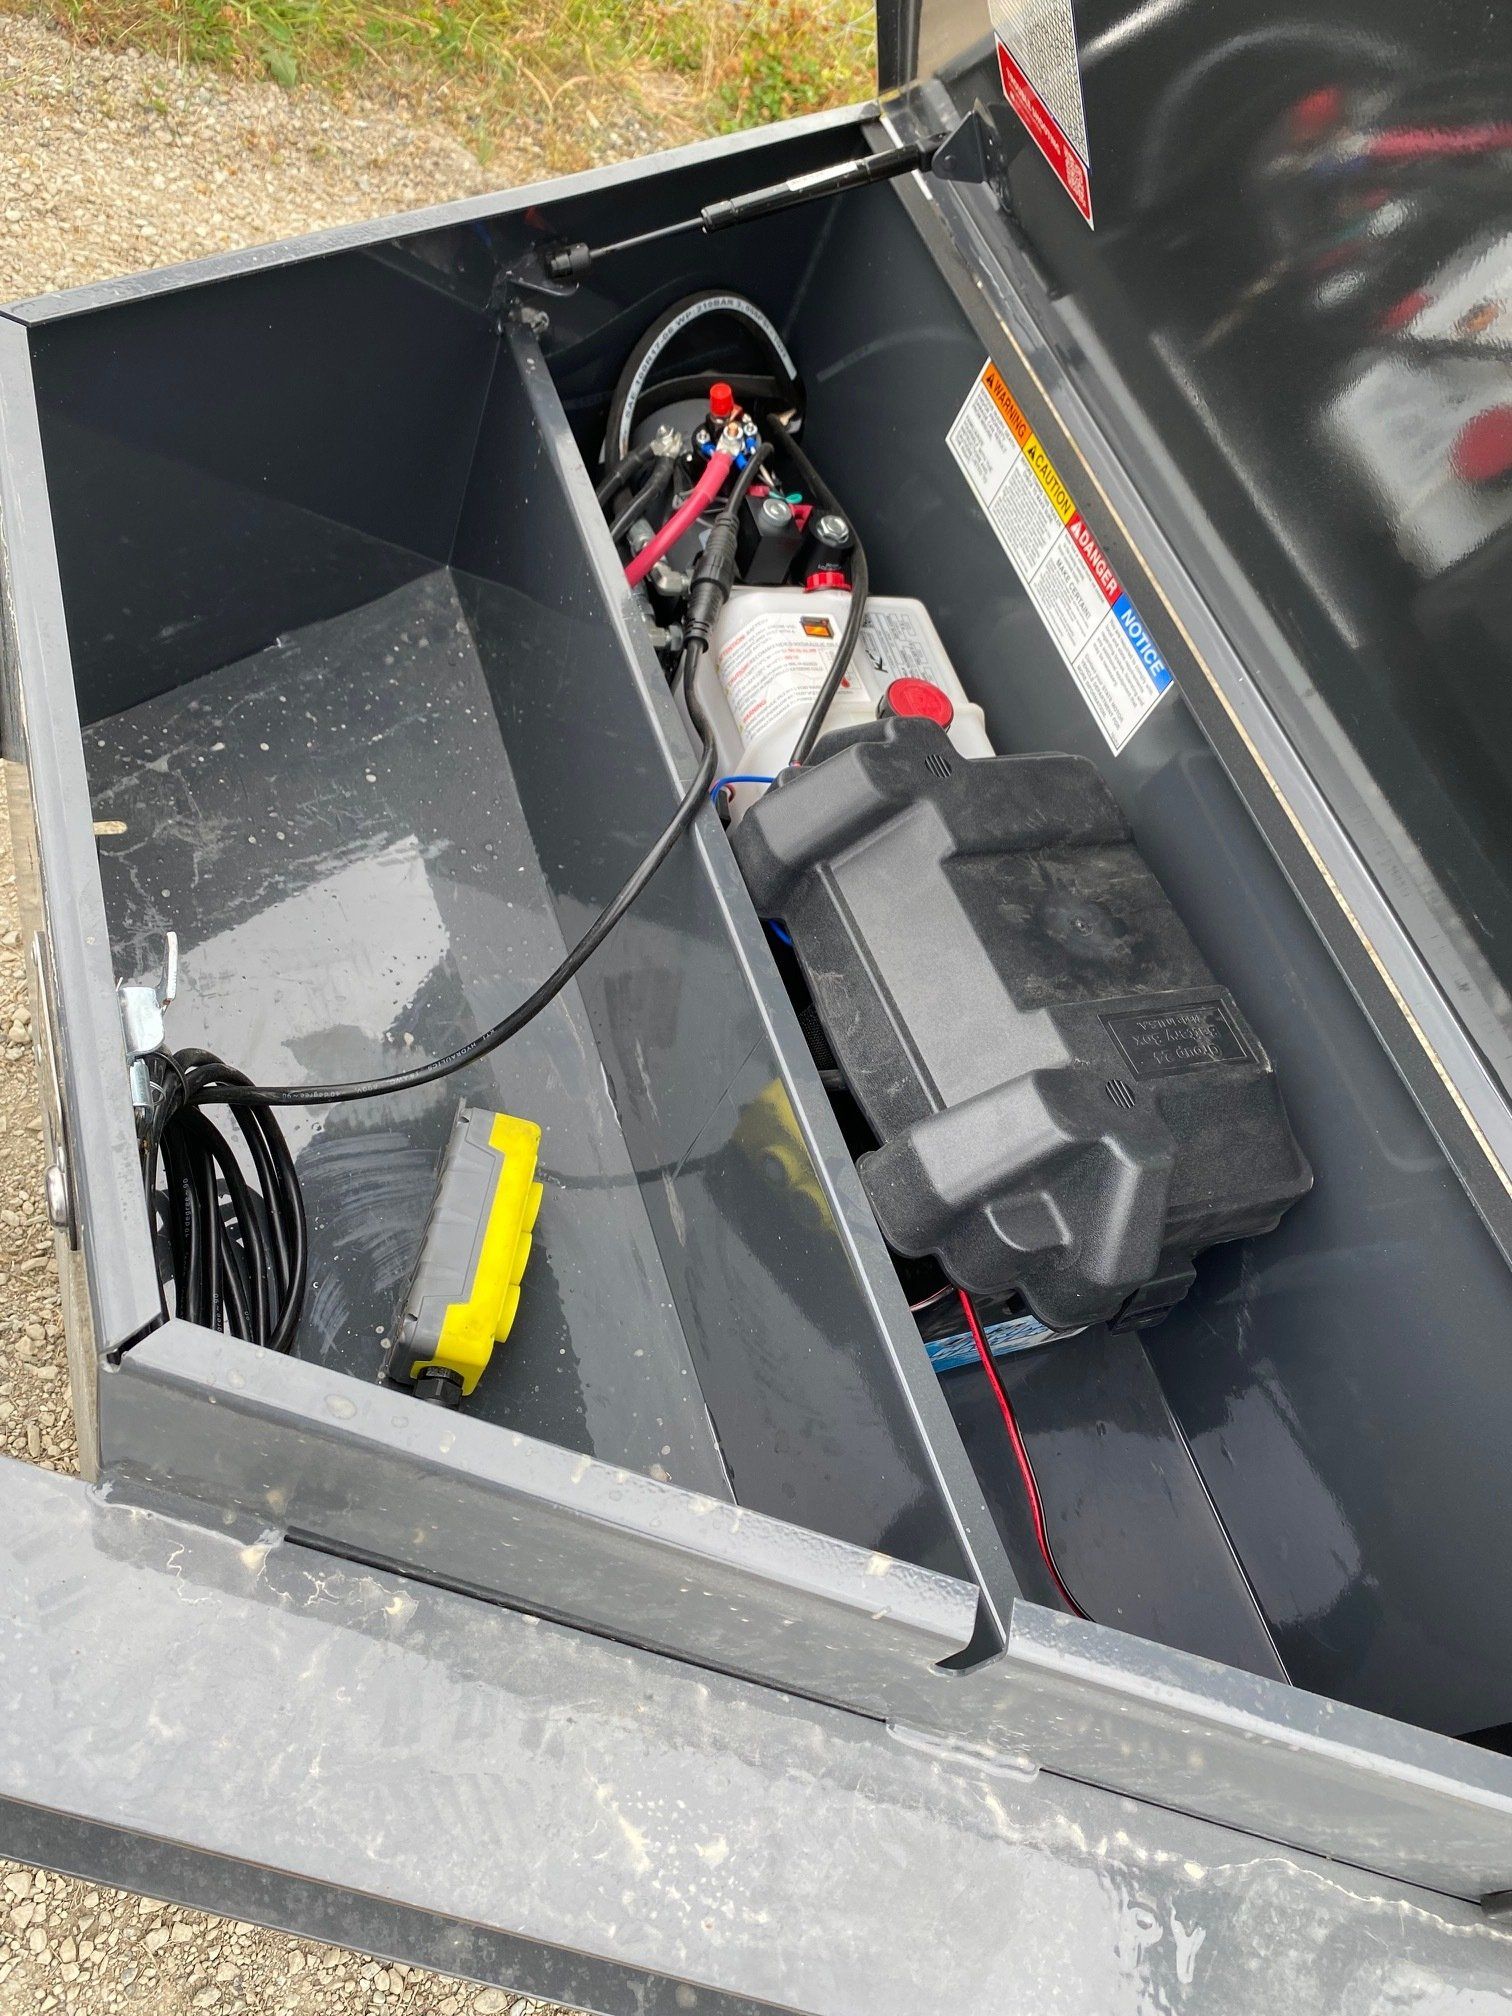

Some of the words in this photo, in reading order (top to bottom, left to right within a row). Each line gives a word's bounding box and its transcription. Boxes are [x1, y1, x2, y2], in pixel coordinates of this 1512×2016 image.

[992, 378, 1027, 439] WARNING
[1034, 451, 1071, 515] CAUTION
[1055, 557, 1070, 583] MAKE
[1077, 528, 1118, 597] DANGER
[1120, 605, 1164, 679] NOTICE
[428, 1042, 477, 1072] HYDRAULICS
[1175, 1042, 1222, 1060] Group
